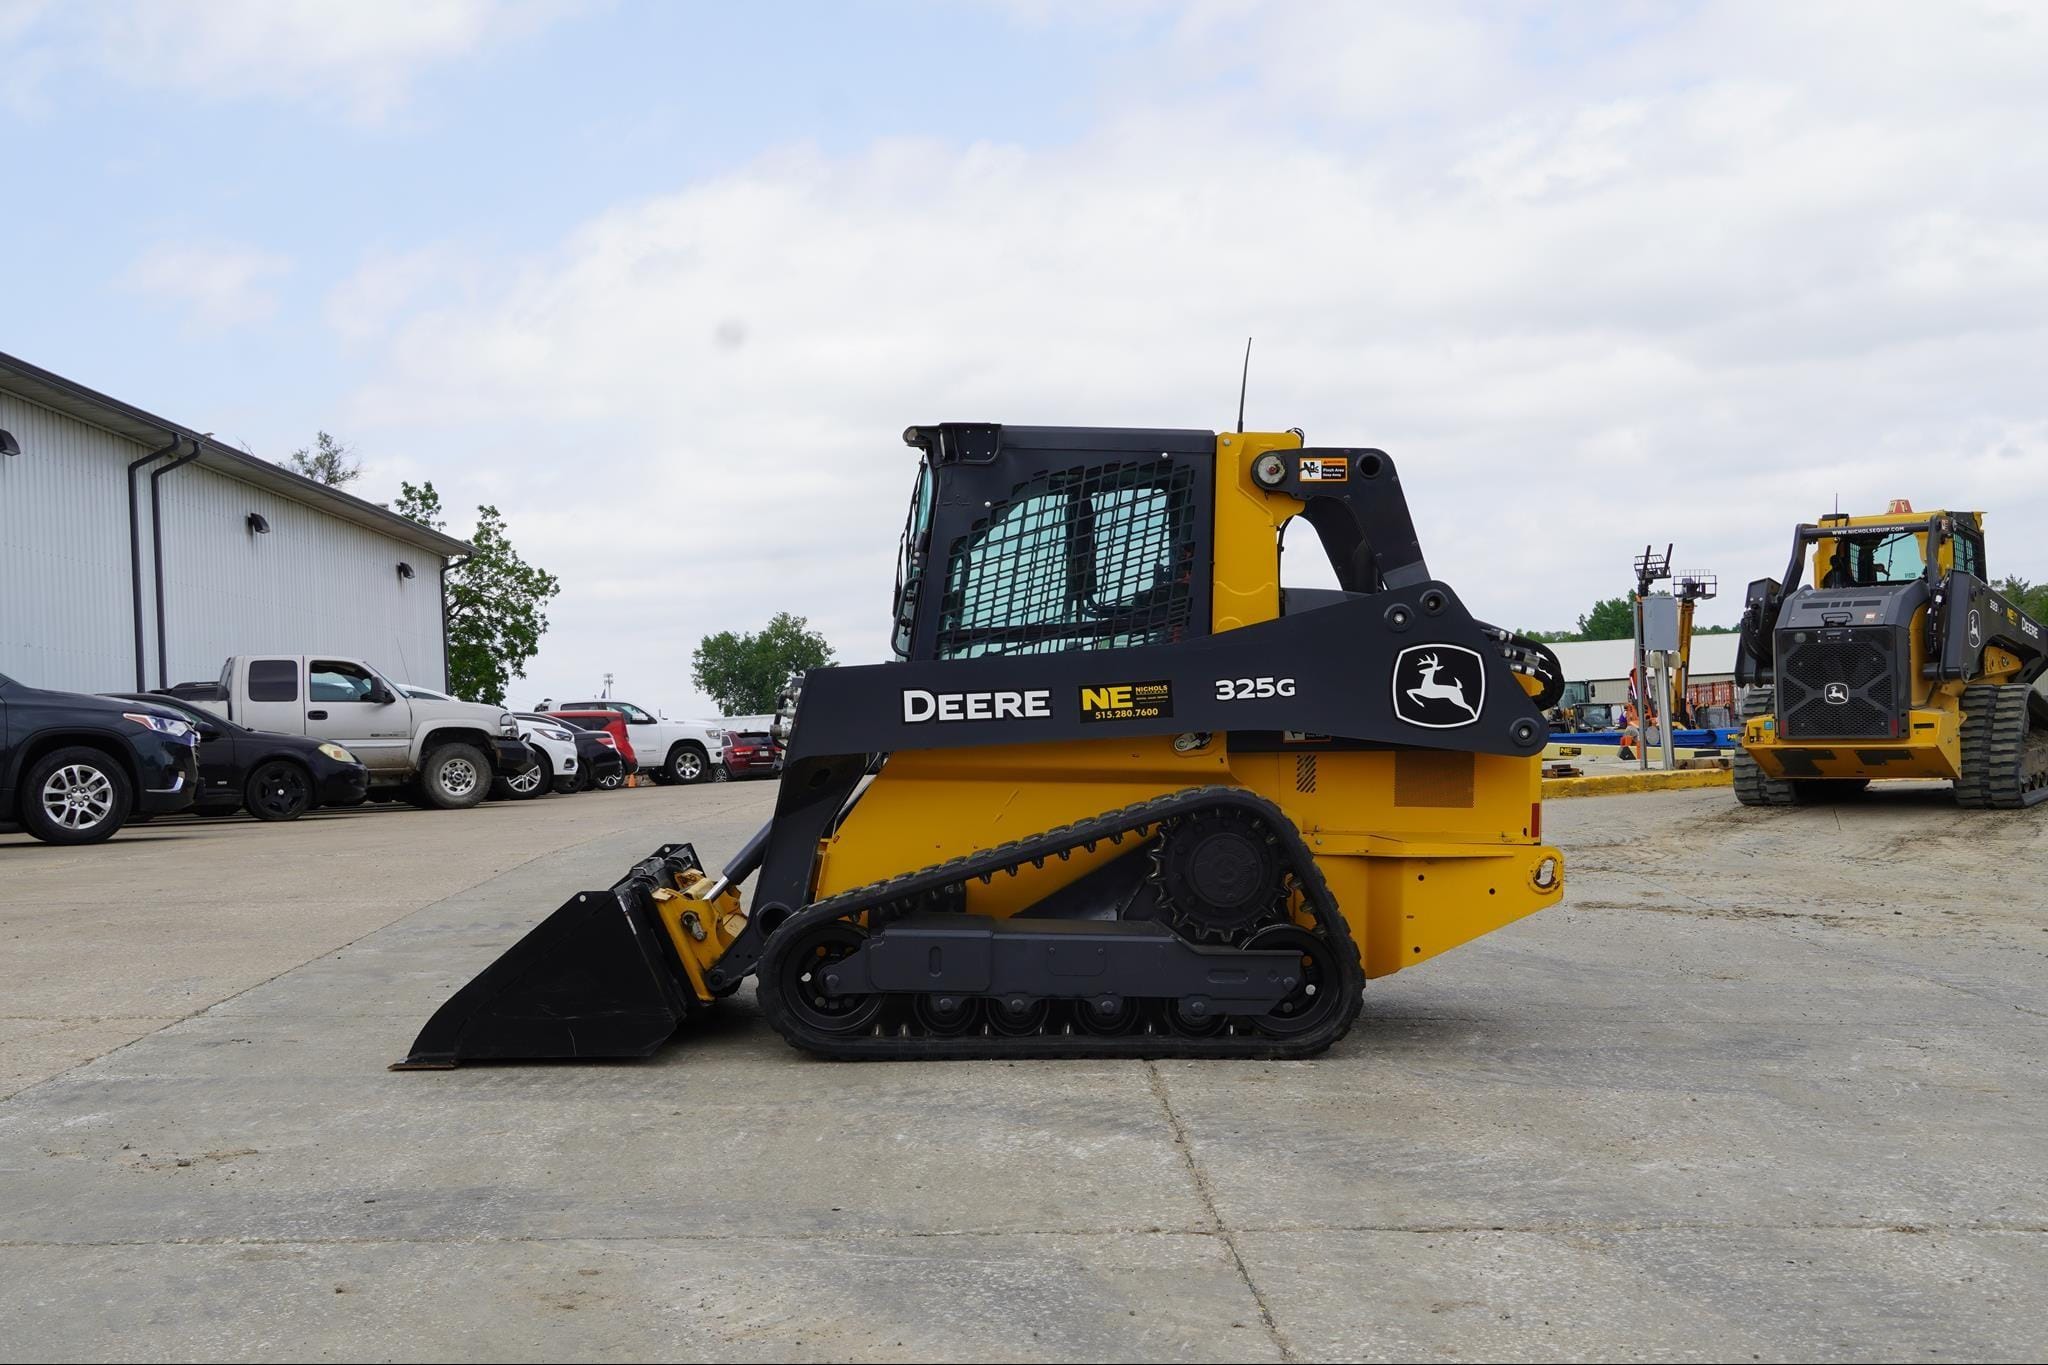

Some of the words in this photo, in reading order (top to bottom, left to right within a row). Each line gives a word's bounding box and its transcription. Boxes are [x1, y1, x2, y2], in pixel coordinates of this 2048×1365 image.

[2021, 616, 2038, 639] DEERE
[1081, 686, 1134, 711] NE
[1215, 677, 1296, 701] 325G
[903, 689, 1051, 723] DEERE
[1095, 708, 1159, 720] 515.280.7600
